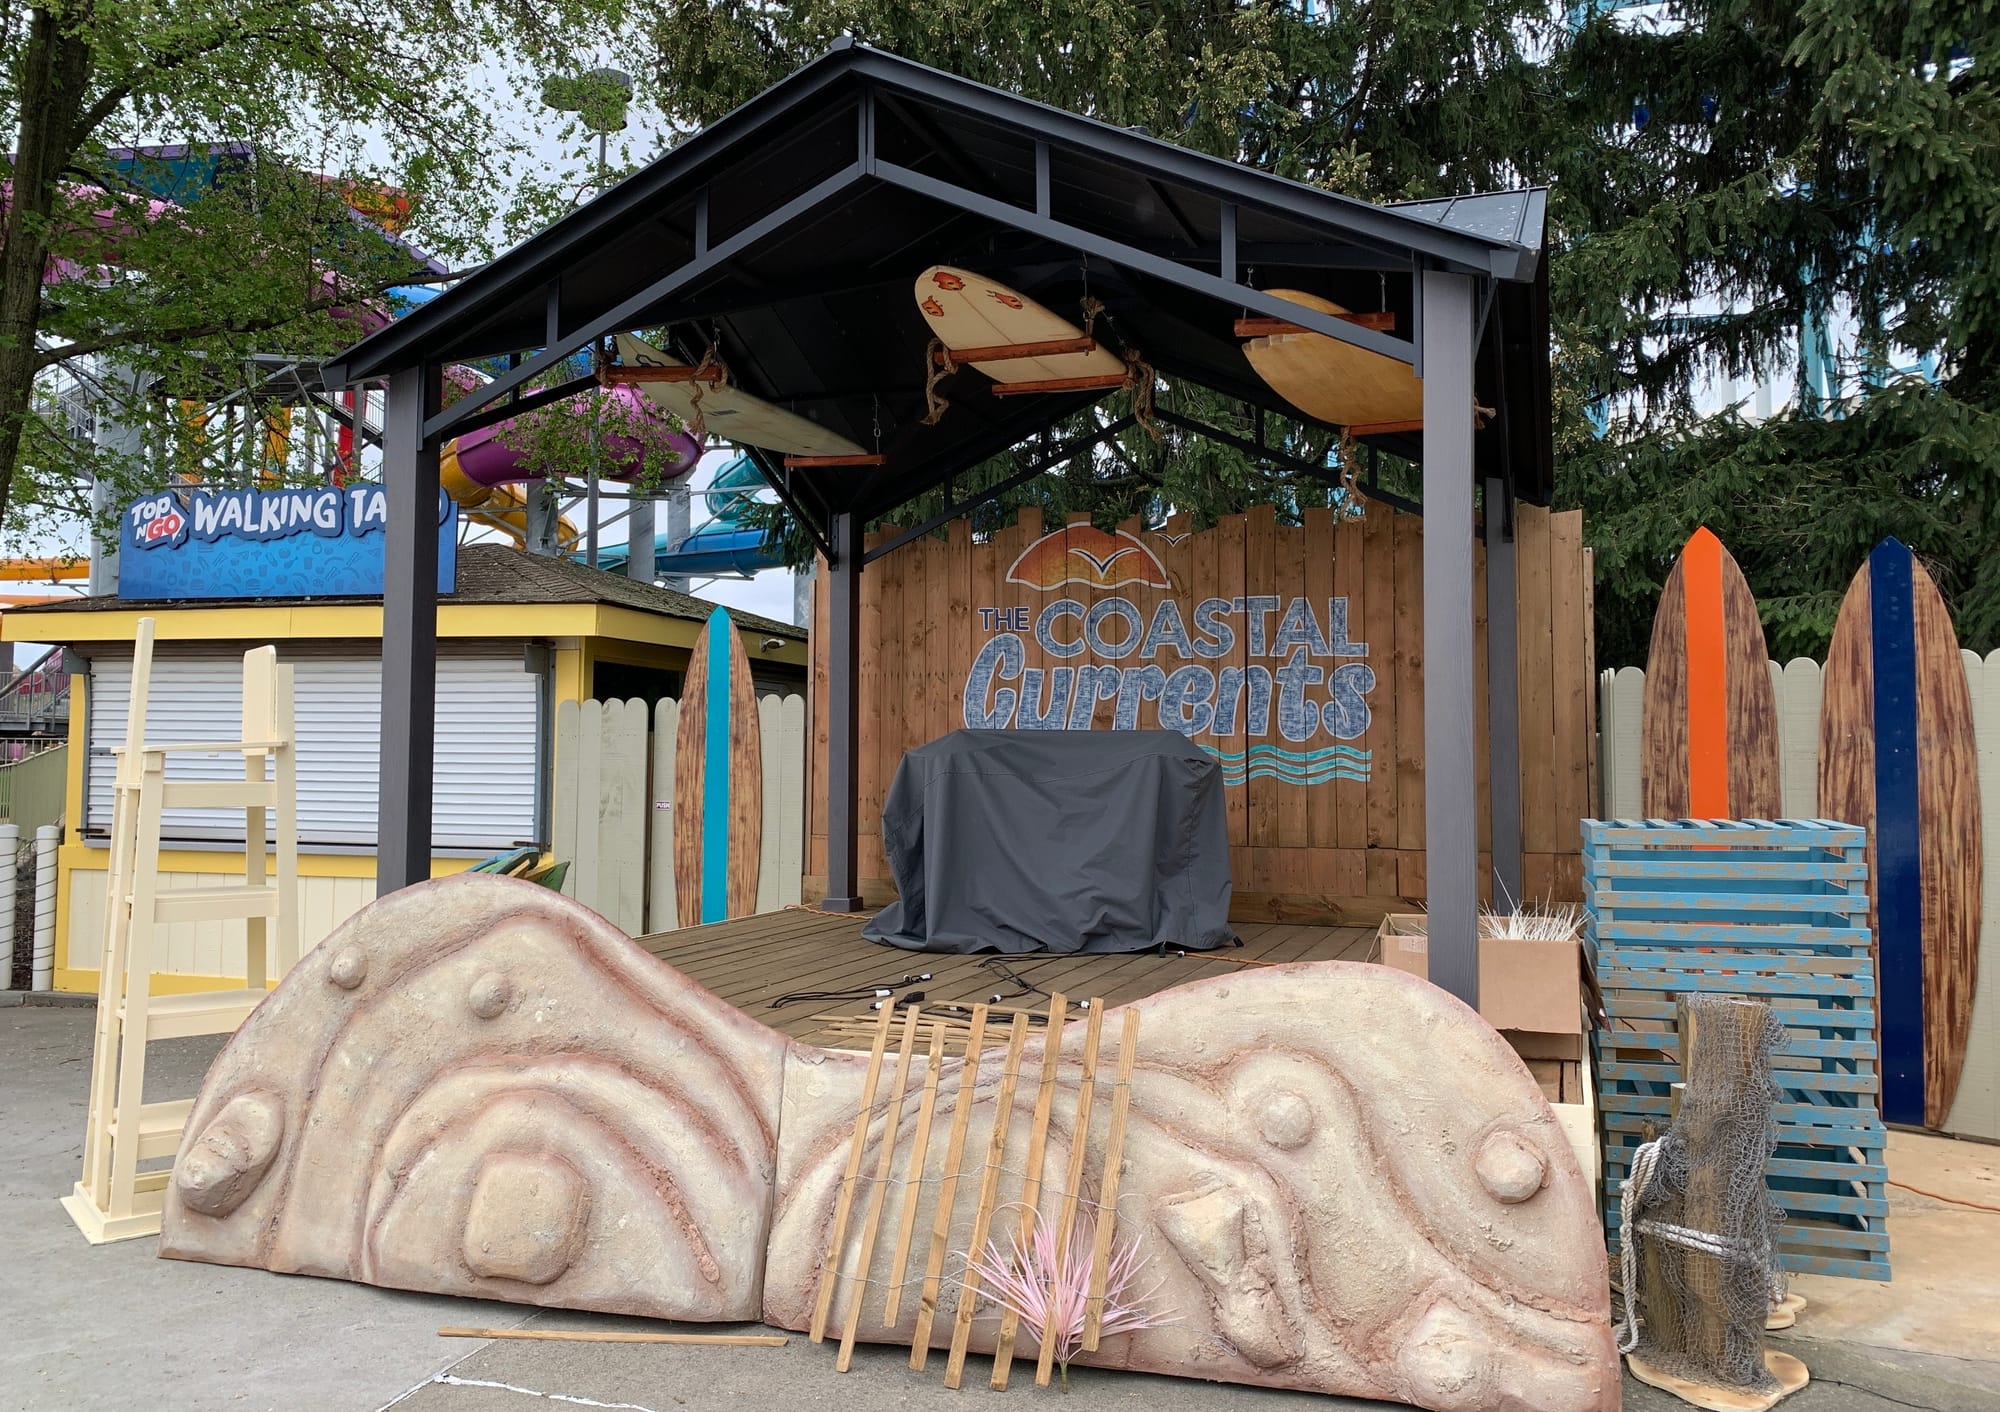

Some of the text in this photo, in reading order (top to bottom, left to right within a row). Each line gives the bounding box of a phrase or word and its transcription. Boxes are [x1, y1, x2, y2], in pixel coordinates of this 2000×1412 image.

[131, 496, 171, 526] TOP
[195, 491, 337, 535] WALKING
[978, 595, 1369, 659] THE COASTAL
[963, 632, 1377, 742] Currents
